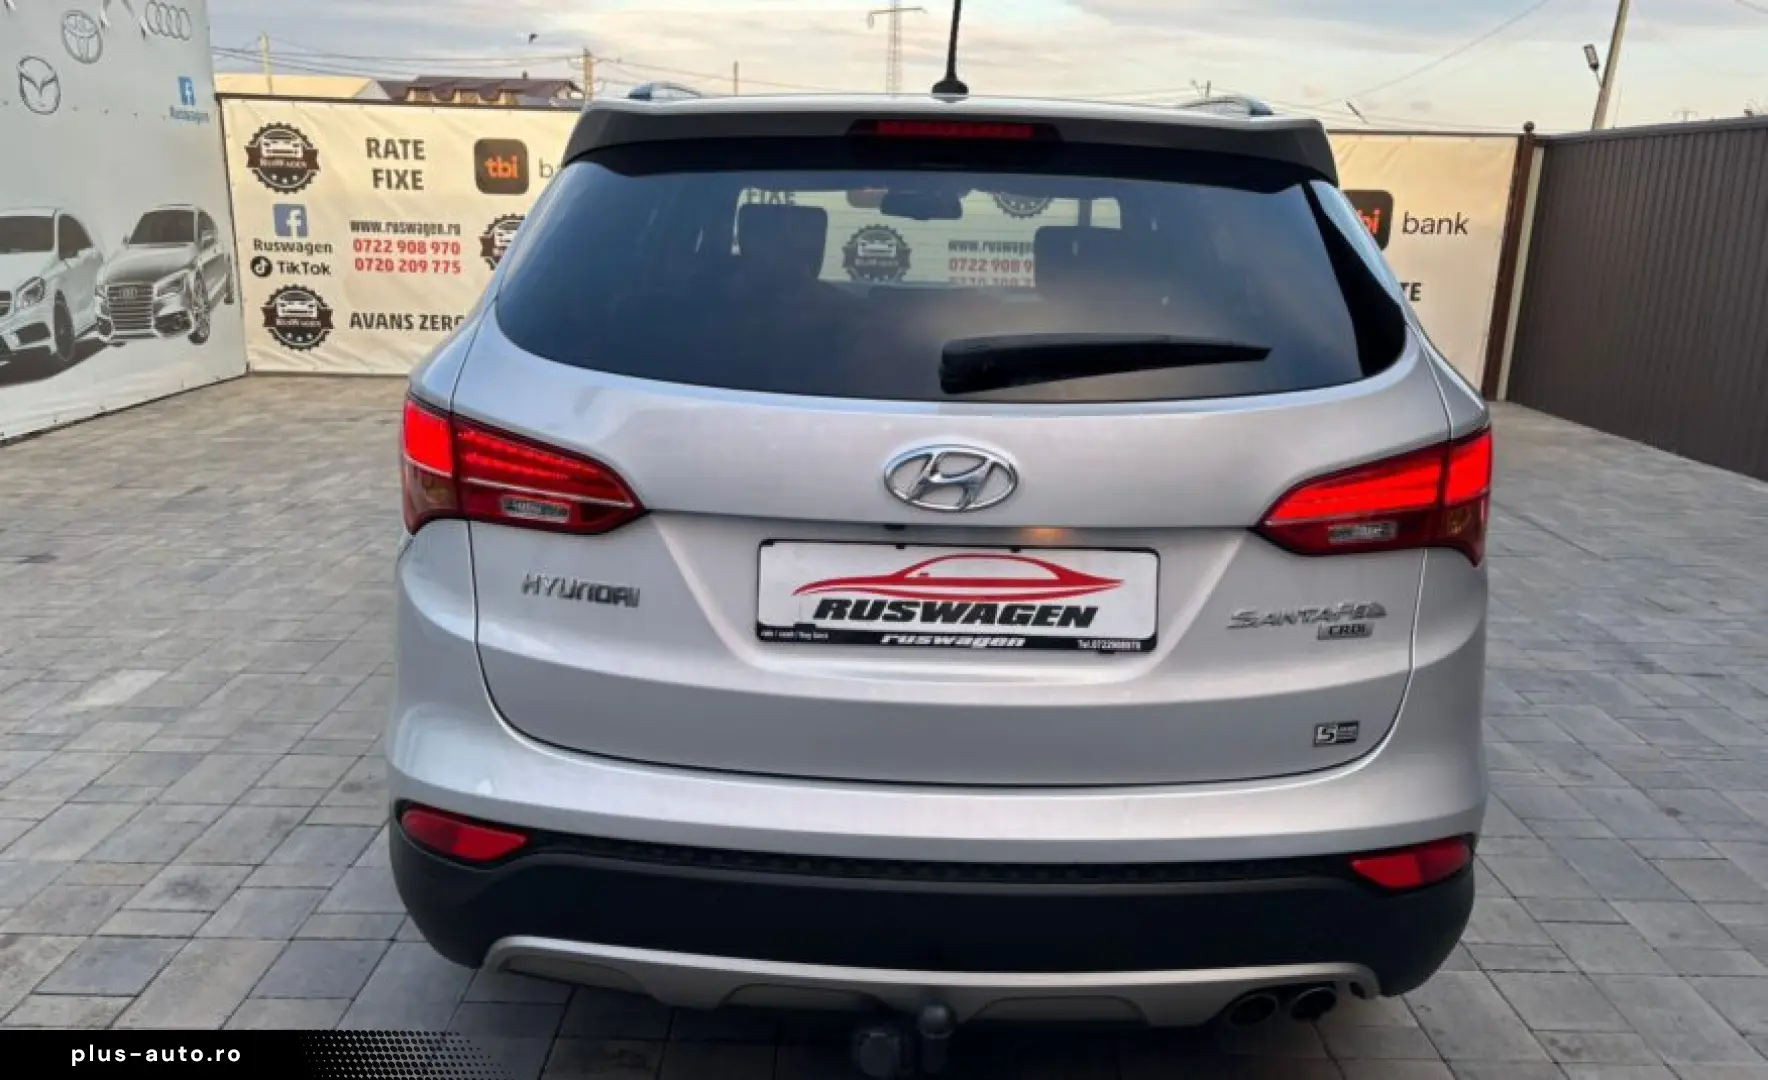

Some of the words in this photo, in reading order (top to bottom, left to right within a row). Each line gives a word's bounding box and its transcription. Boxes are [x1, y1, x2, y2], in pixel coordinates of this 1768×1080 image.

[366, 138, 425, 161] RATE
[484, 155, 518, 179] tbi
[372, 169, 424, 190] FIXE
[1402, 211, 1469, 235] bank
[253, 238, 333, 256] Ruswagen
[353, 238, 392, 253] 0722
[397, 239, 427, 255] 908
[431, 240, 461, 256] 970
[277, 260, 331, 276] TikTok
[354, 258, 394, 273] 0720
[398, 259, 428, 274] 209
[432, 260, 461, 275] 775
[349, 312, 413, 330] AVANS
[521, 573, 640, 608] HYUNDAI
[813, 598, 1099, 629] RUSWAGEN
[881, 633, 1026, 649] ruswagen
